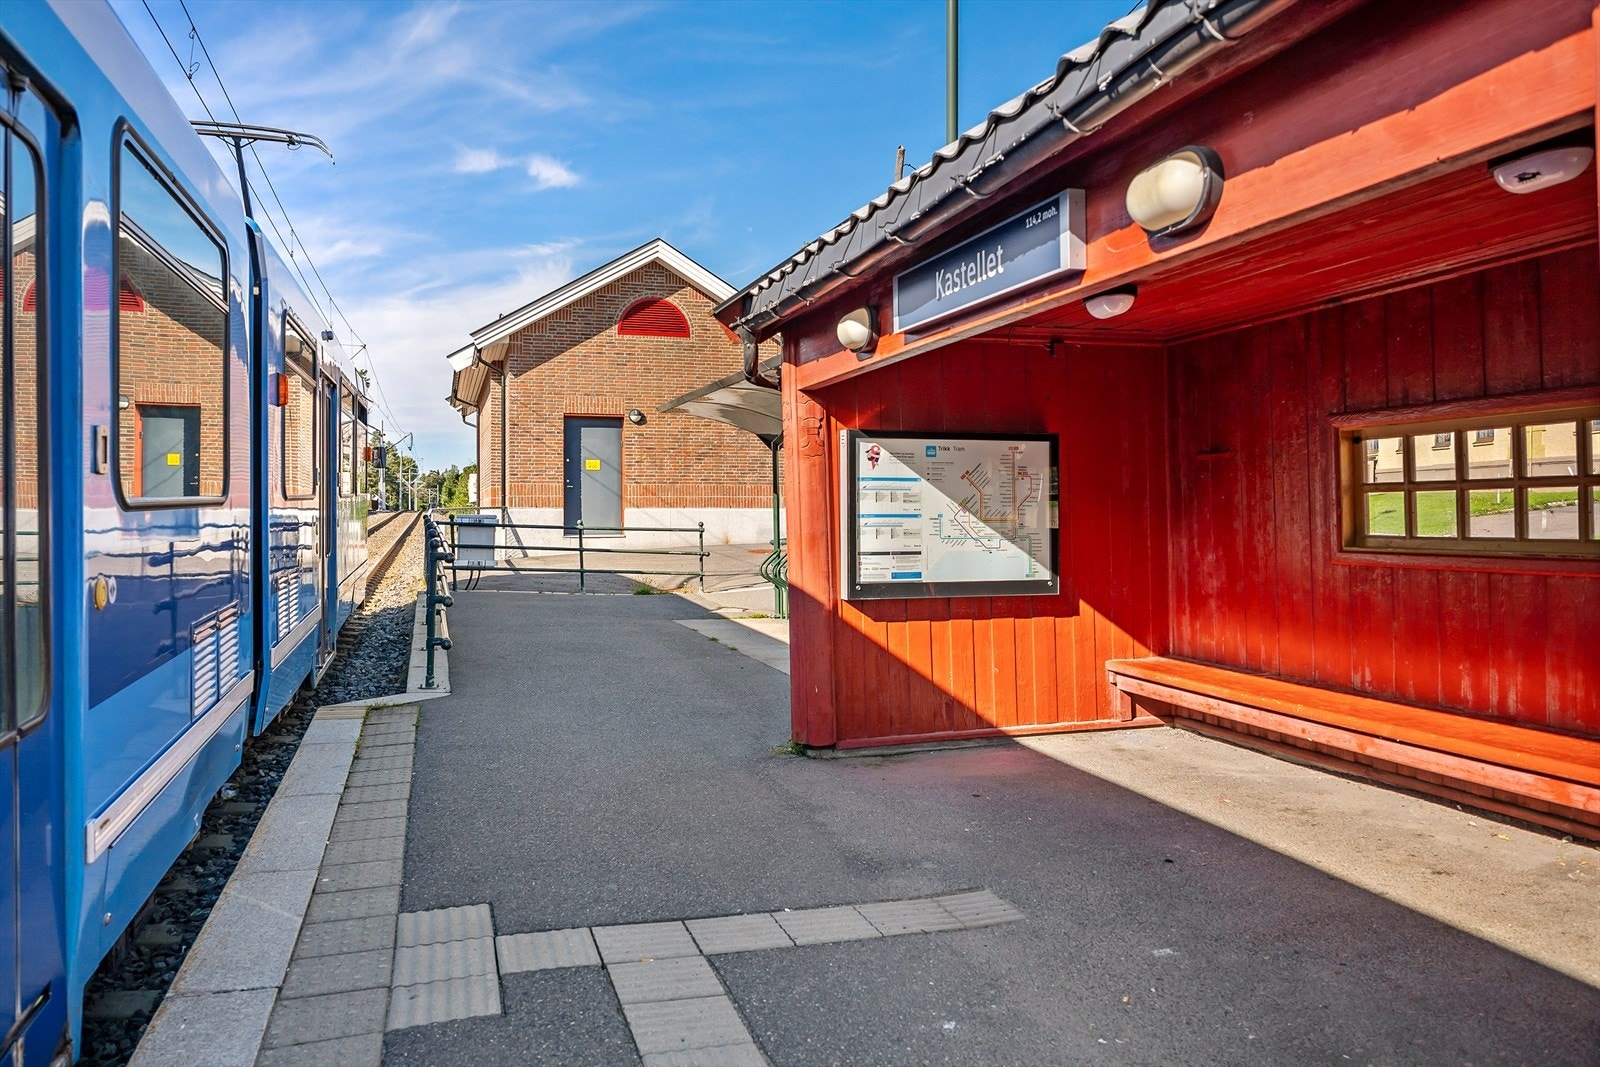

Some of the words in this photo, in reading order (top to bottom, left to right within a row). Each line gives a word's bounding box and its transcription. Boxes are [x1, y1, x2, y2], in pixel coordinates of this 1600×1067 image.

[1026, 212, 1041, 228] 114,2
[1042, 206, 1058, 220] moh.
[935, 245, 1004, 299] Kastellet
